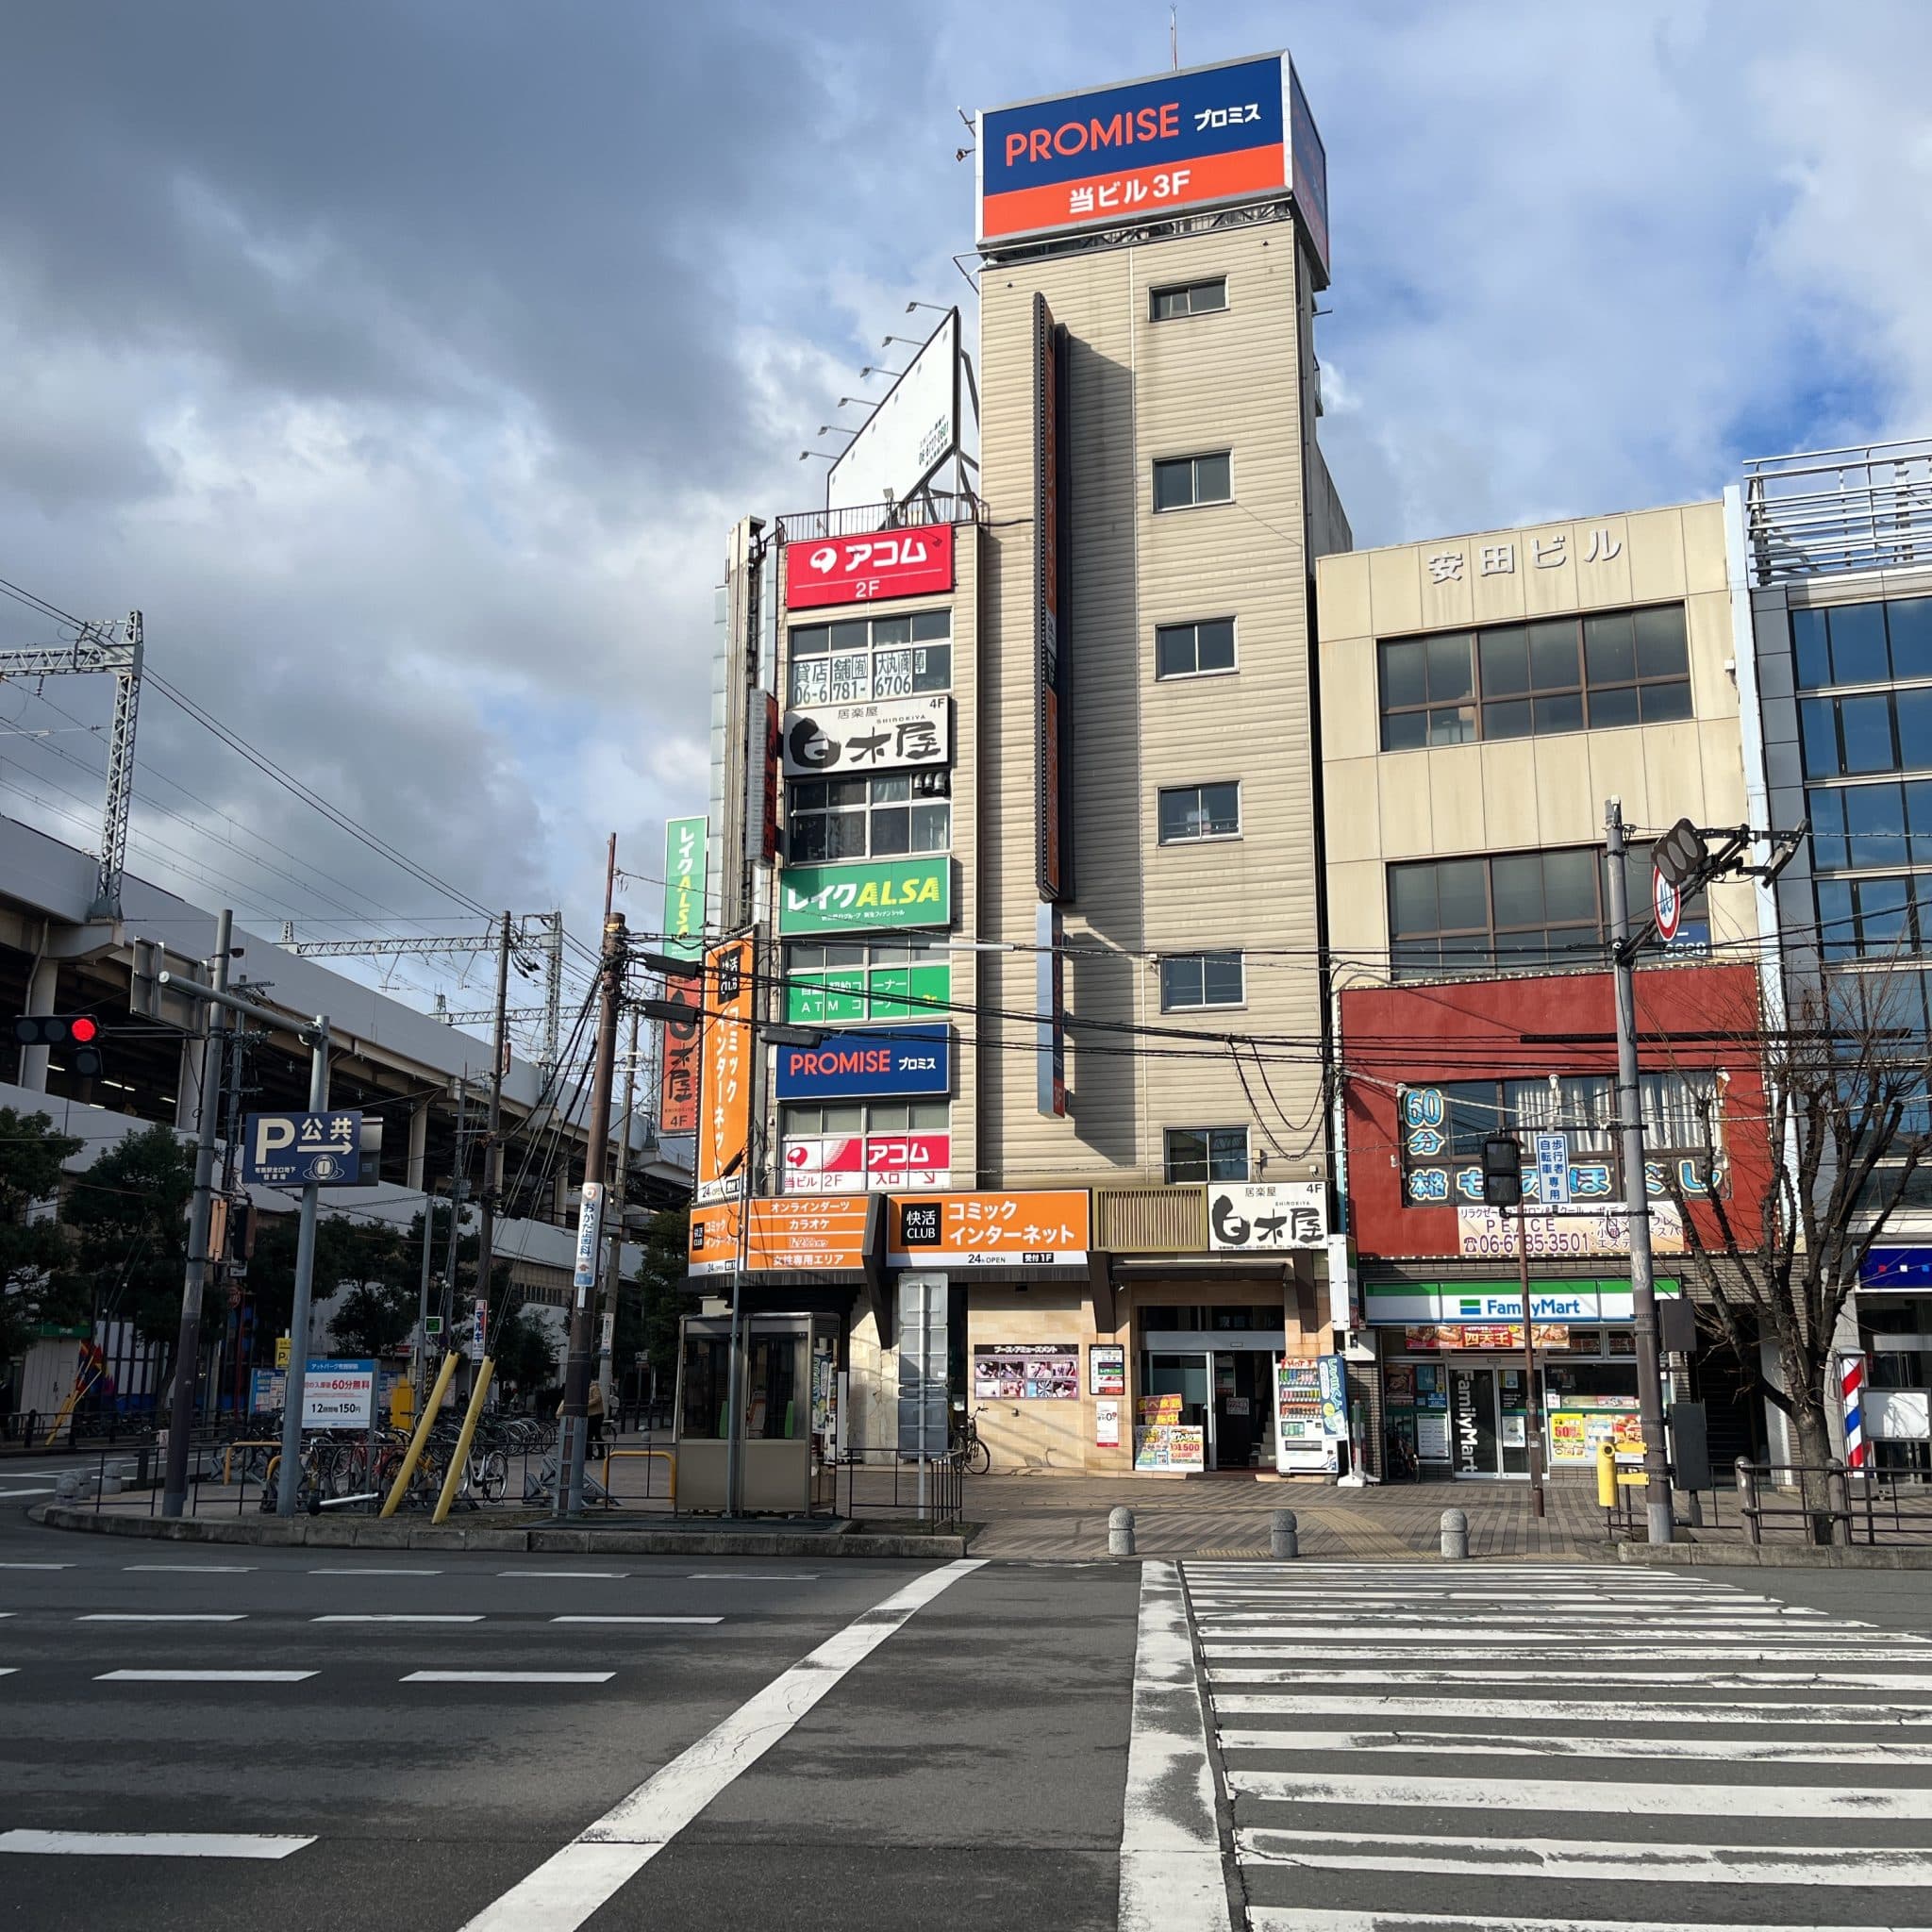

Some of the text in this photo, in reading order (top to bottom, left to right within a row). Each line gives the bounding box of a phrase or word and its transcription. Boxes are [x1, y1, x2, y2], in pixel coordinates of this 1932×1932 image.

[1006, 102, 1261, 166] PROMISE プロミス
[1068, 170, 1191, 214] 当ビル3F
[844, 539, 927, 572] アコム
[1428, 529, 1622, 584] 安田ビル
[855, 580, 880, 598] 2F
[929, 698, 945, 708] 4F
[838, 707, 878, 720] 居楽屋
[876, 714, 926, 724] SHIROKIYA
[789, 717, 941, 769] 白木屋
[787, 876, 941, 912] レイクALSA
[802, 1000, 839, 1012] ATM
[791, 1050, 936, 1075] PROMISE プロミス
[670, 1115, 688, 1127] 4F
[256, 1117, 353, 1165] P 公共
[868, 1142, 929, 1164] アコム
[1540, 1140, 1552, 1174] 自転車
[1552, 1140, 1564, 1174] 歩行者
[785, 1173, 900, 1189] 当ビル 2F 入口
[1307, 1183, 1323, 1193] 4F
[1245, 1186, 1276, 1197] 居楽屋
[771, 1201, 850, 1213] オンラインダーツ
[948, 1201, 1017, 1221] コミック
[789, 1219, 830, 1230] カラオケ
[907, 1209, 936, 1225] 快活
[1212, 1194, 1324, 1245] 白木屋
[907, 1227, 936, 1239] CLUB
[949, 1224, 1075, 1245] インターネット
[1486, 1219, 1556, 1233] PECE
[774, 1254, 844, 1266] 女性専用エリア
[1487, 1299, 1581, 1316] FamyMart
